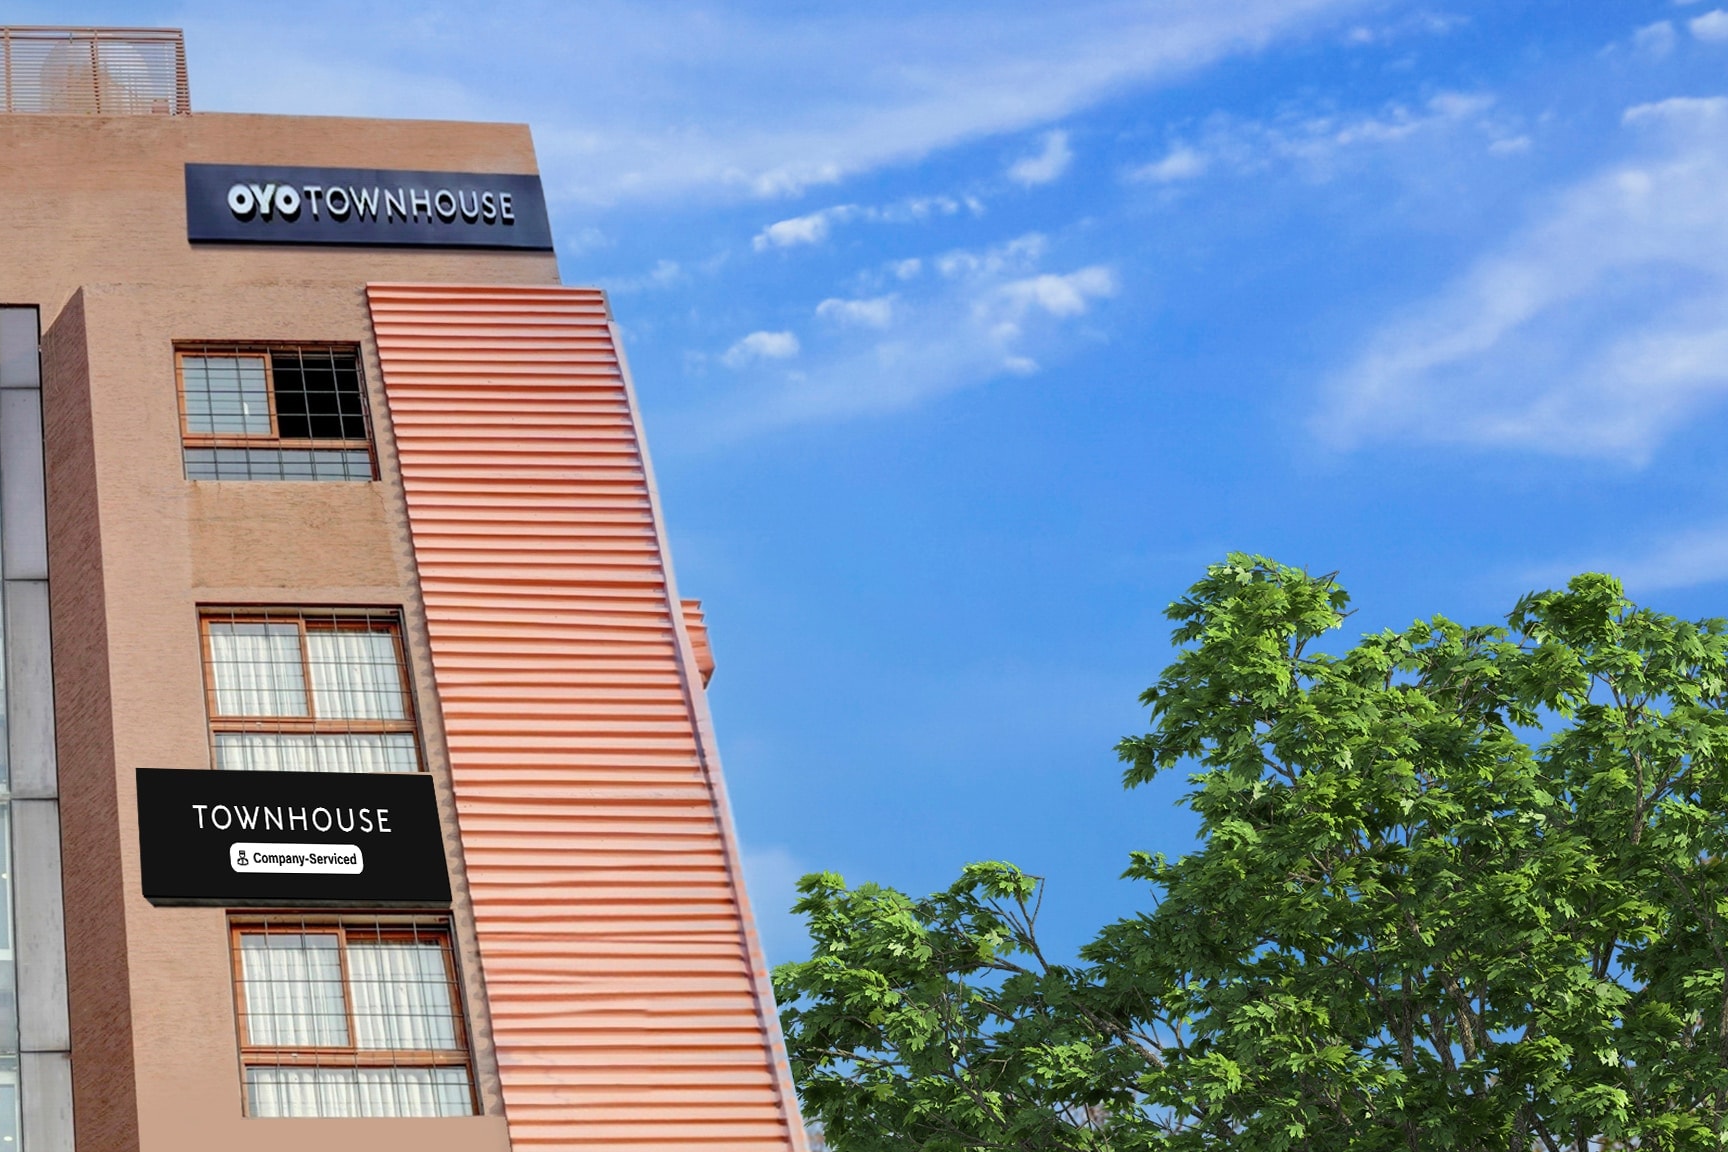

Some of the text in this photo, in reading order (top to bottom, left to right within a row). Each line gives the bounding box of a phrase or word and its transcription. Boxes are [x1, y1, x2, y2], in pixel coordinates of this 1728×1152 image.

[227, 183, 516, 220] OYO TOWNHOUSE
[191, 804, 393, 833] TOWNHOUSE
[252, 852, 358, 867] Company-Serviced
